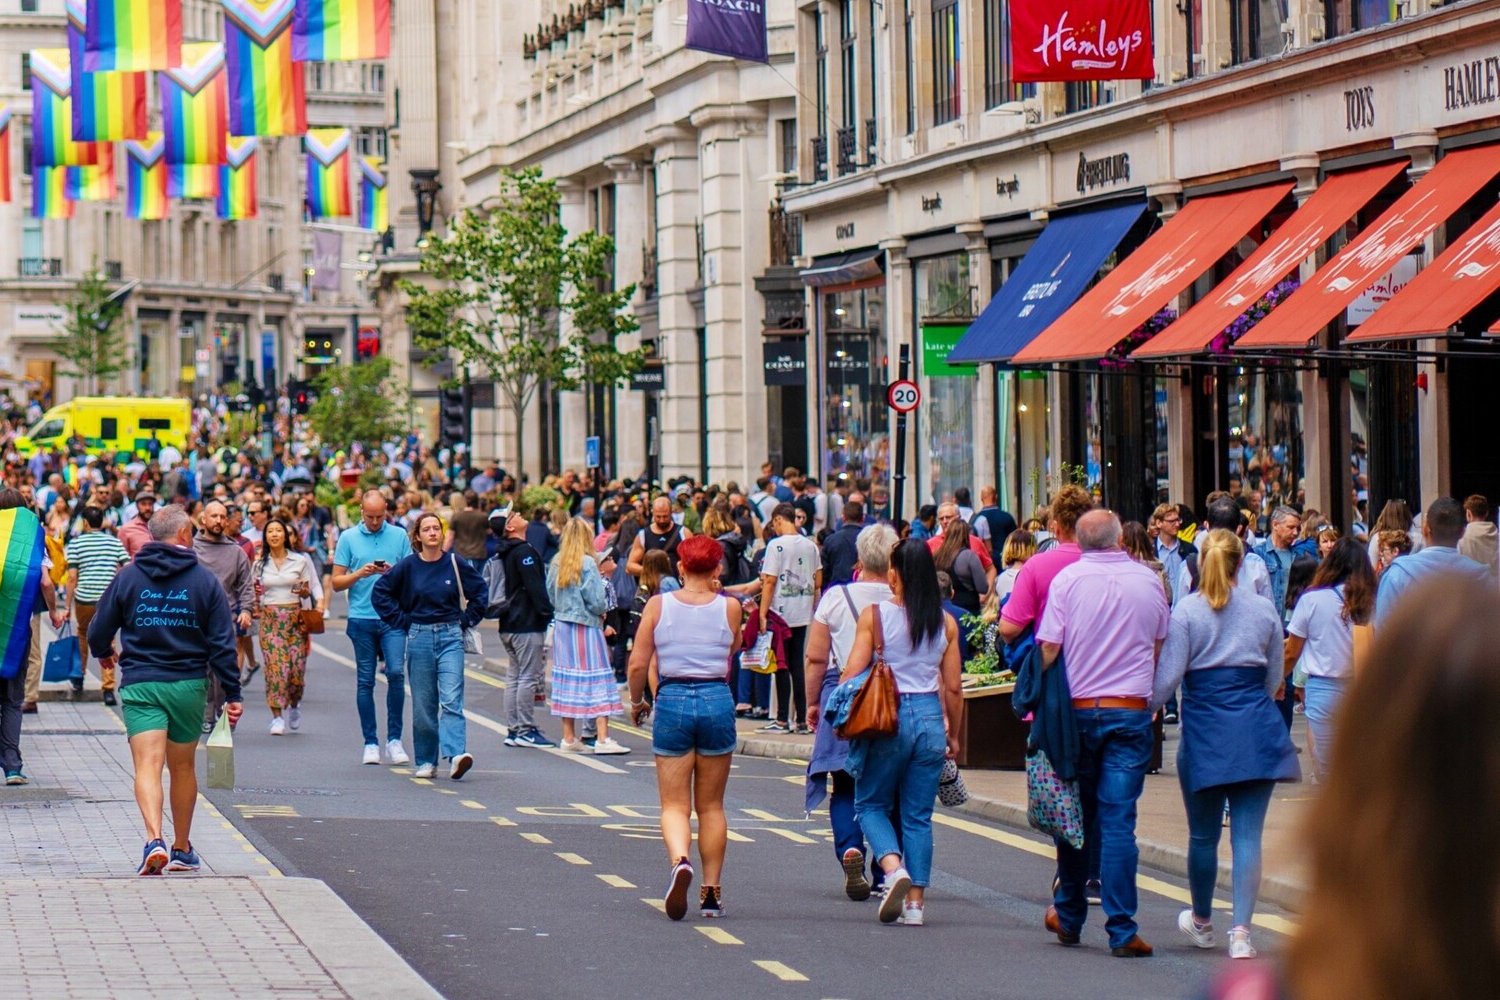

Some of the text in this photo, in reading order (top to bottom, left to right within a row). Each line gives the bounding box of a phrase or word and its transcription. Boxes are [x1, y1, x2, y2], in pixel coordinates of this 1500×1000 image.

[1033, 10, 1142, 71] Hamleys
[1344, 85, 1375, 131] TOYS
[1085, 153, 1130, 190] BREITLING
[925, 341, 946, 350] kate
[765, 360, 805, 369] COACH
[895, 390, 917, 403] 20
[140, 589, 163, 600] One
[136, 603, 159, 613] One
[135, 616, 200, 629] CORNWALL
